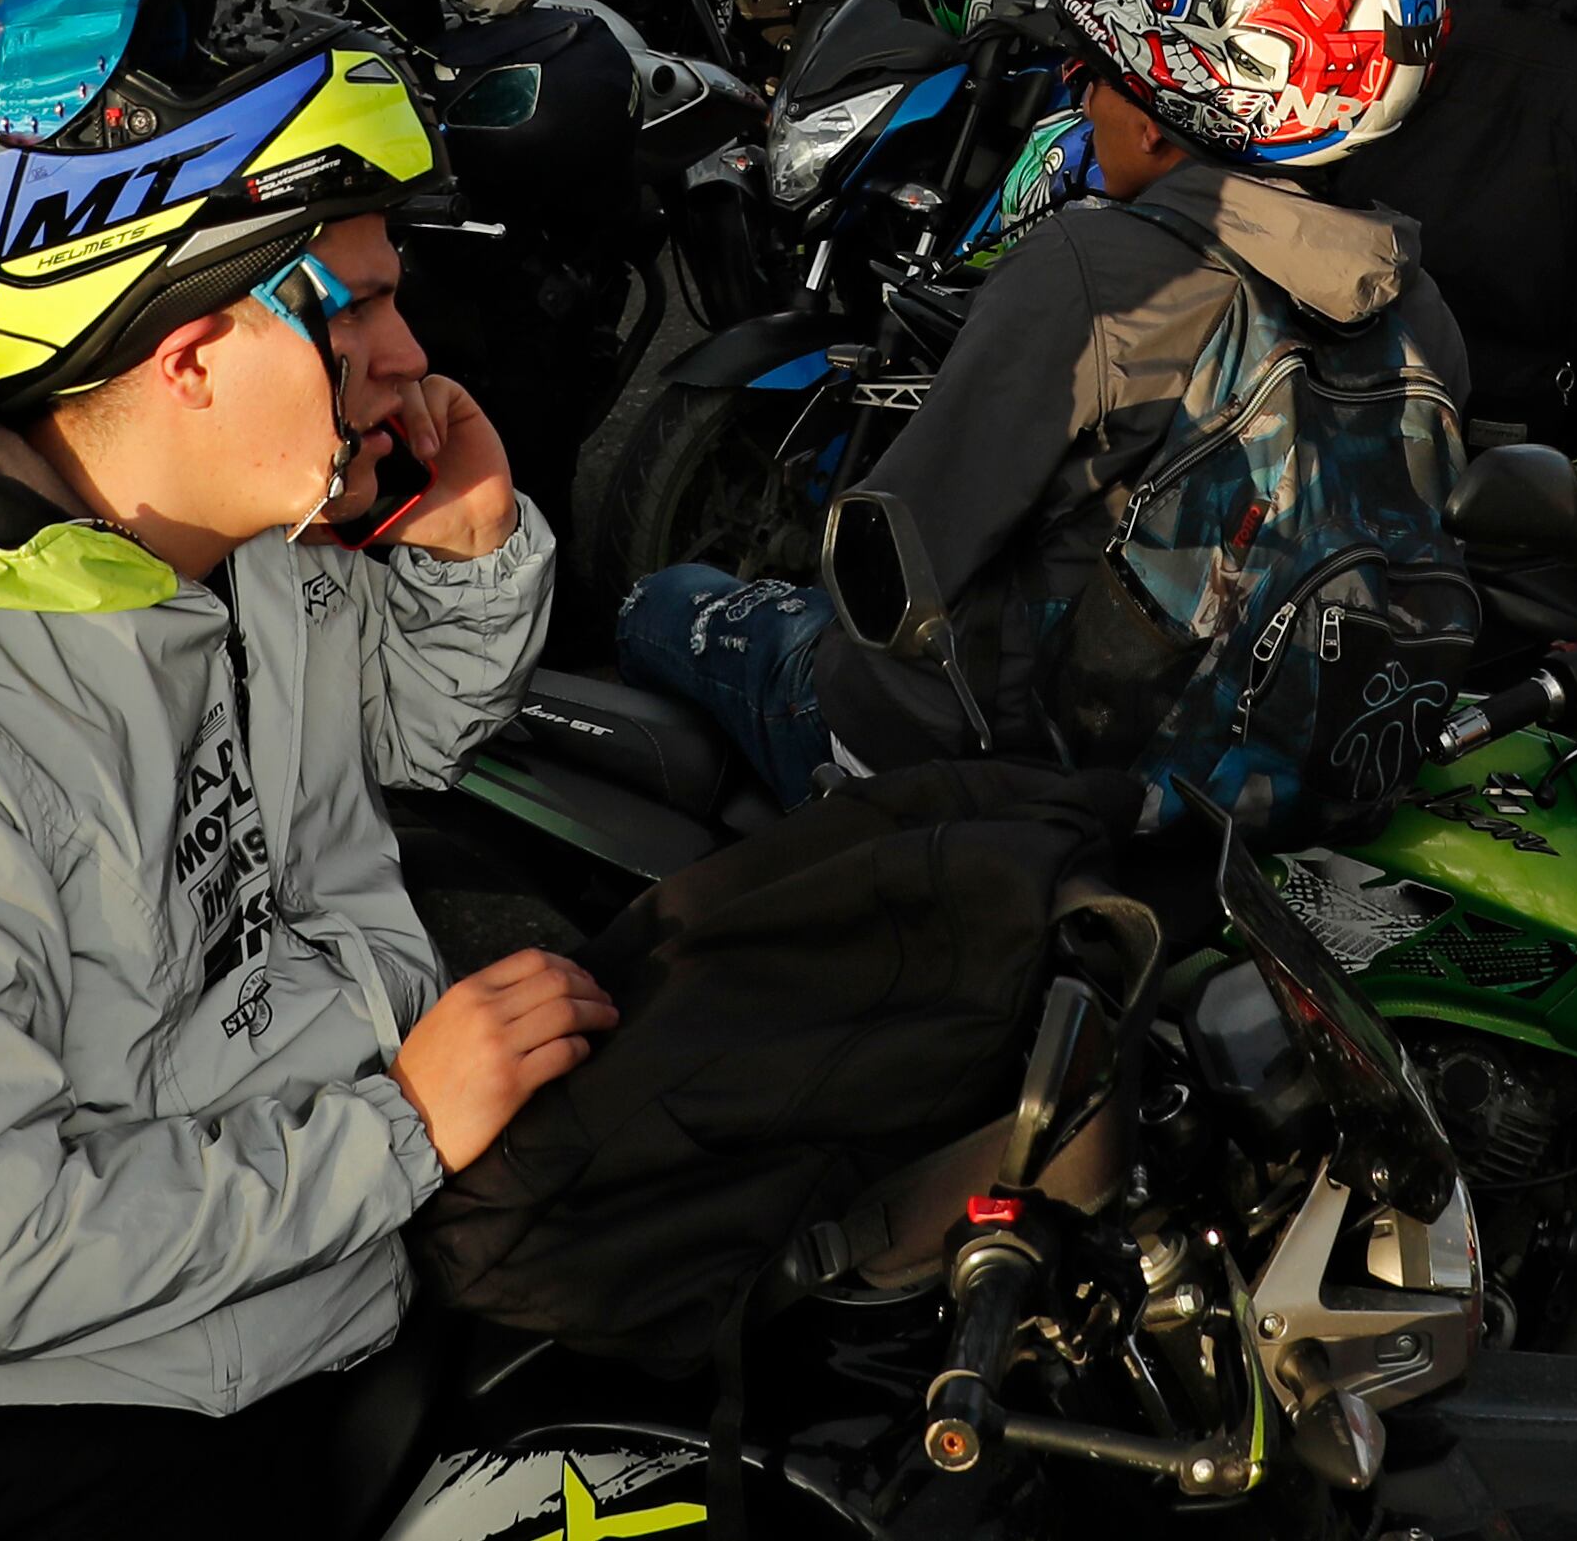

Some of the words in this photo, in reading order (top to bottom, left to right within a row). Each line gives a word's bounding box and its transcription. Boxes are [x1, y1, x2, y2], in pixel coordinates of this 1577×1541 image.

[3, 132, 238, 258] MT
[260, 186, 296, 202] SHELL
[37, 224, 153, 272] HELMETS
